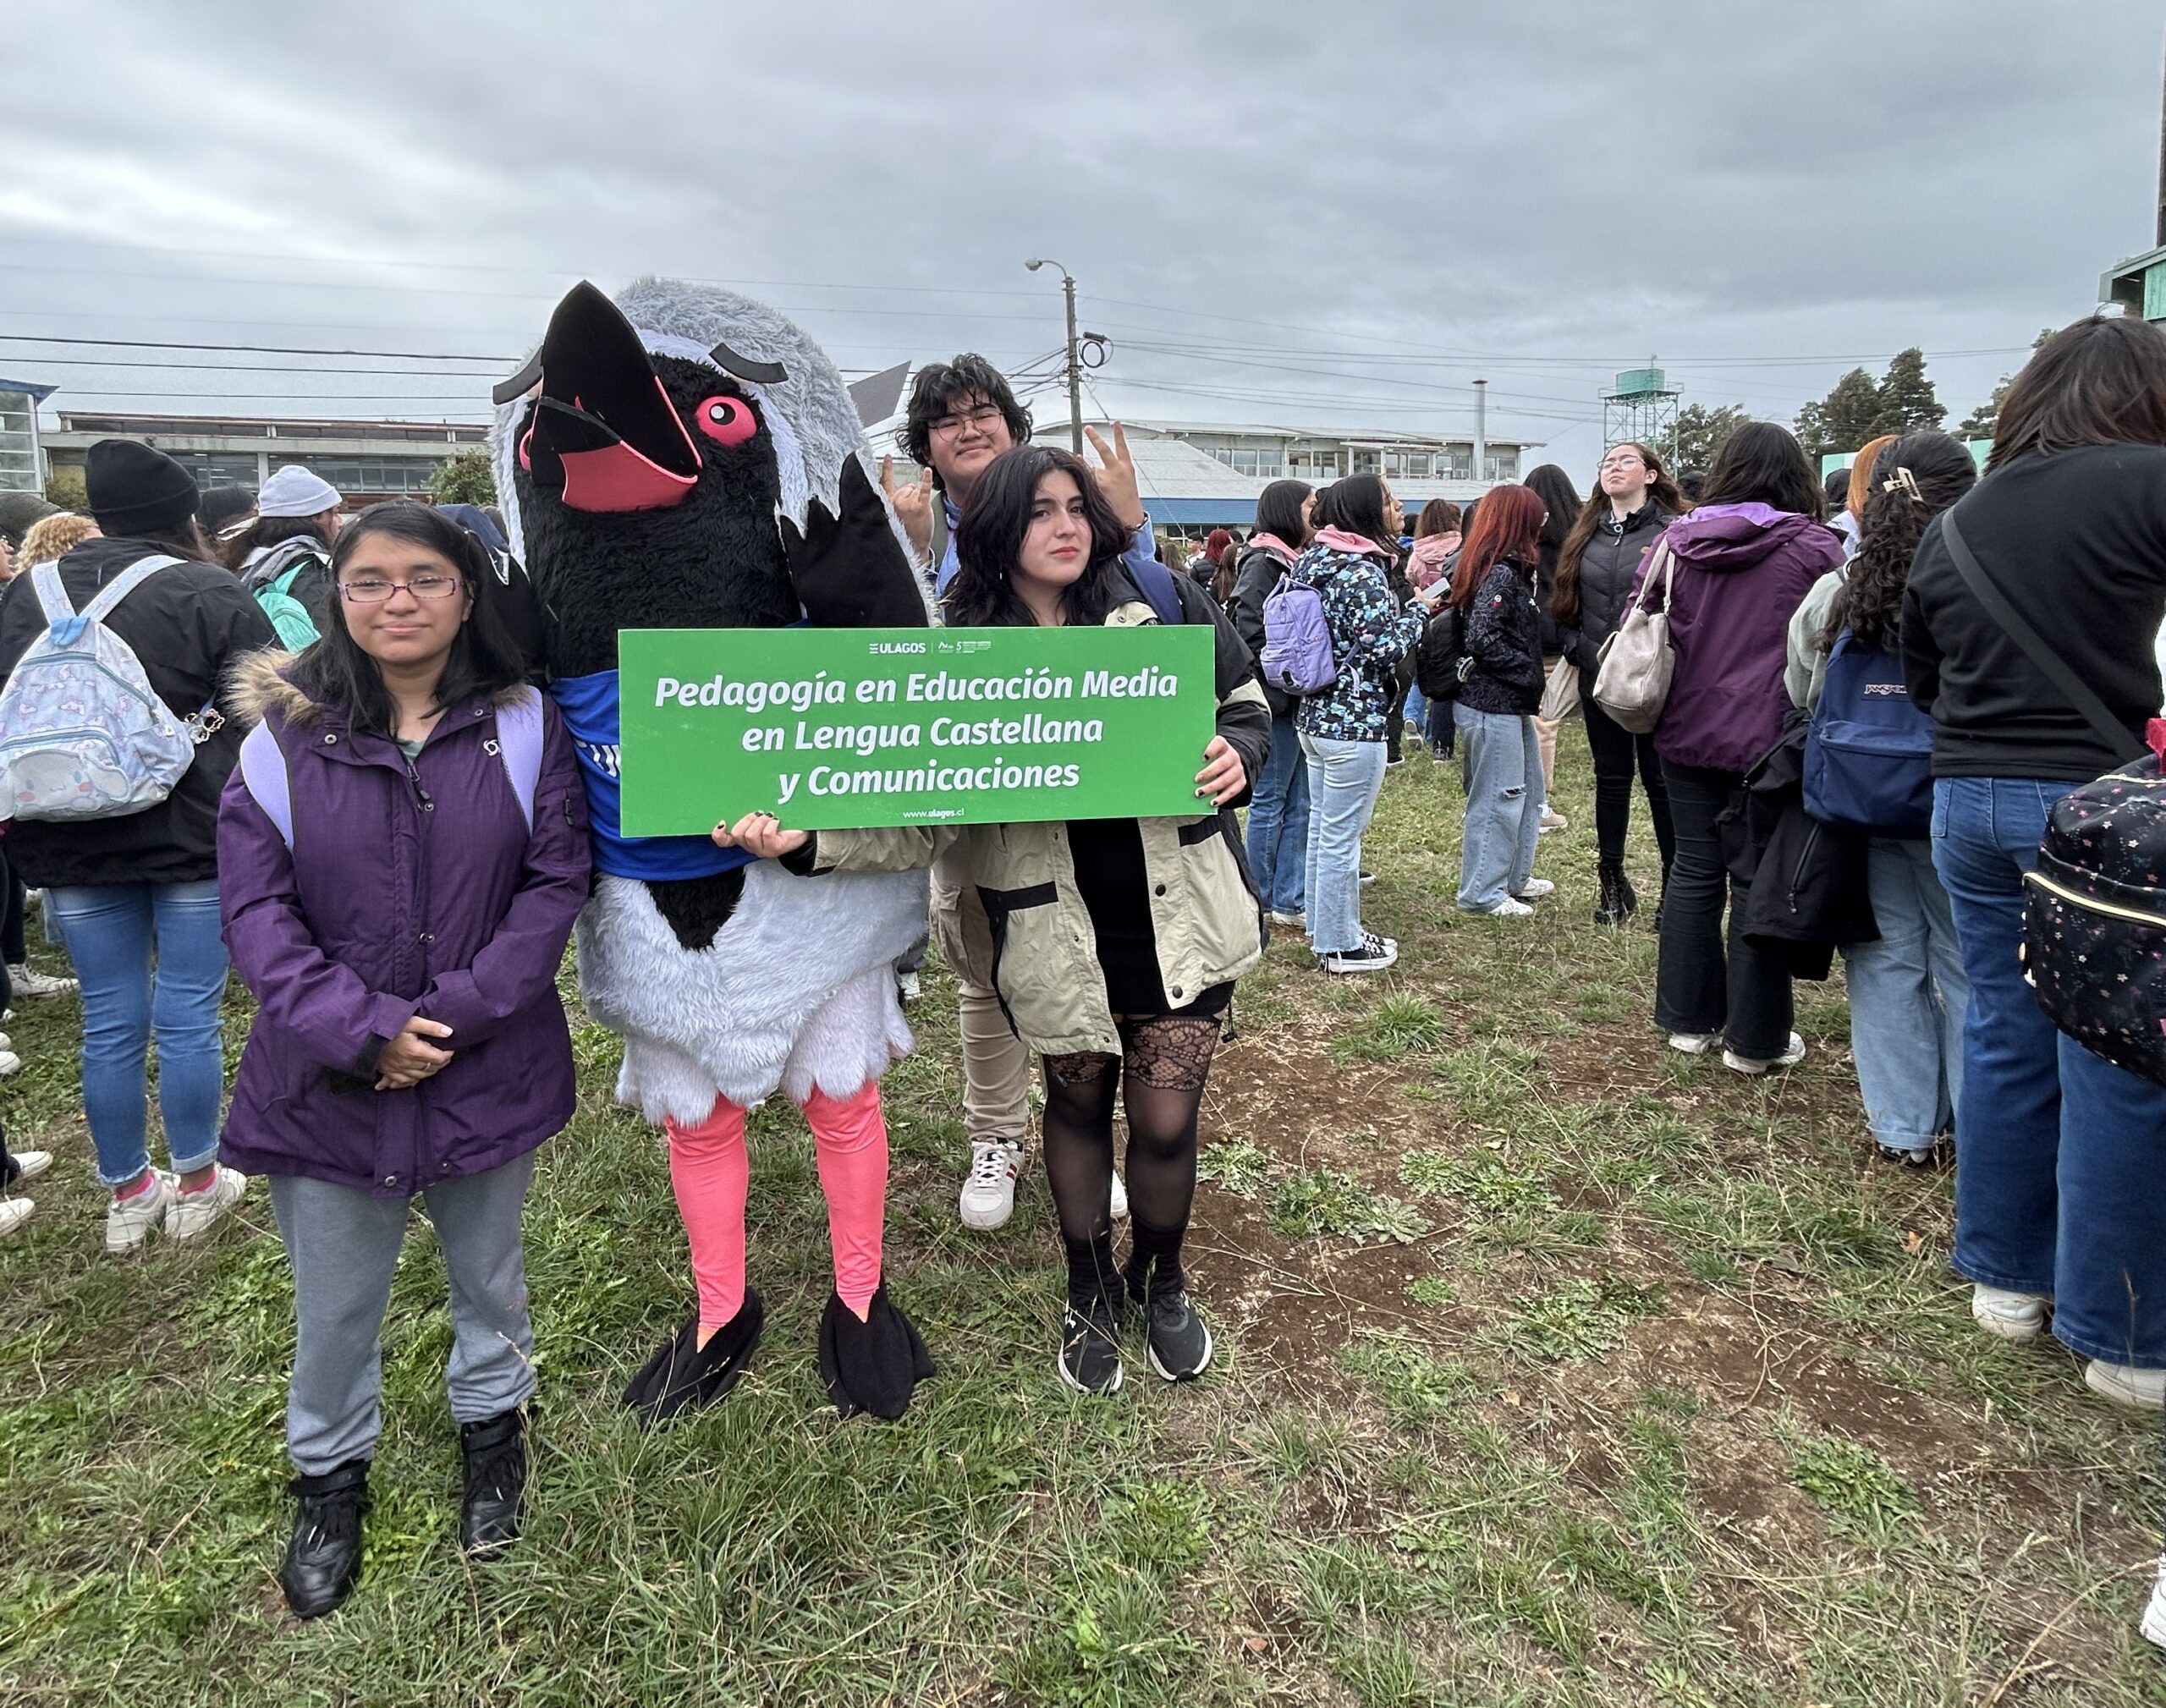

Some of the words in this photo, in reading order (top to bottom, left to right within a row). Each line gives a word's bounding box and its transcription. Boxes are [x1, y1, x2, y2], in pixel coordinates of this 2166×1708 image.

[879, 642, 926, 654] ULAGOS
[655, 670, 846, 714] Pedagogía
[855, 679, 897, 704] en
[905, 666, 1073, 702] Educación
[1080, 665, 1178, 698] Media
[741, 727, 785, 752] en
[794, 721, 921, 756] Lengua
[930, 712, 1103, 748] Castellana
[777, 773, 801, 805] y
[808, 756, 1080, 796] Comunicaciones
[902, 808, 965, 819] www.ulagos.cl
